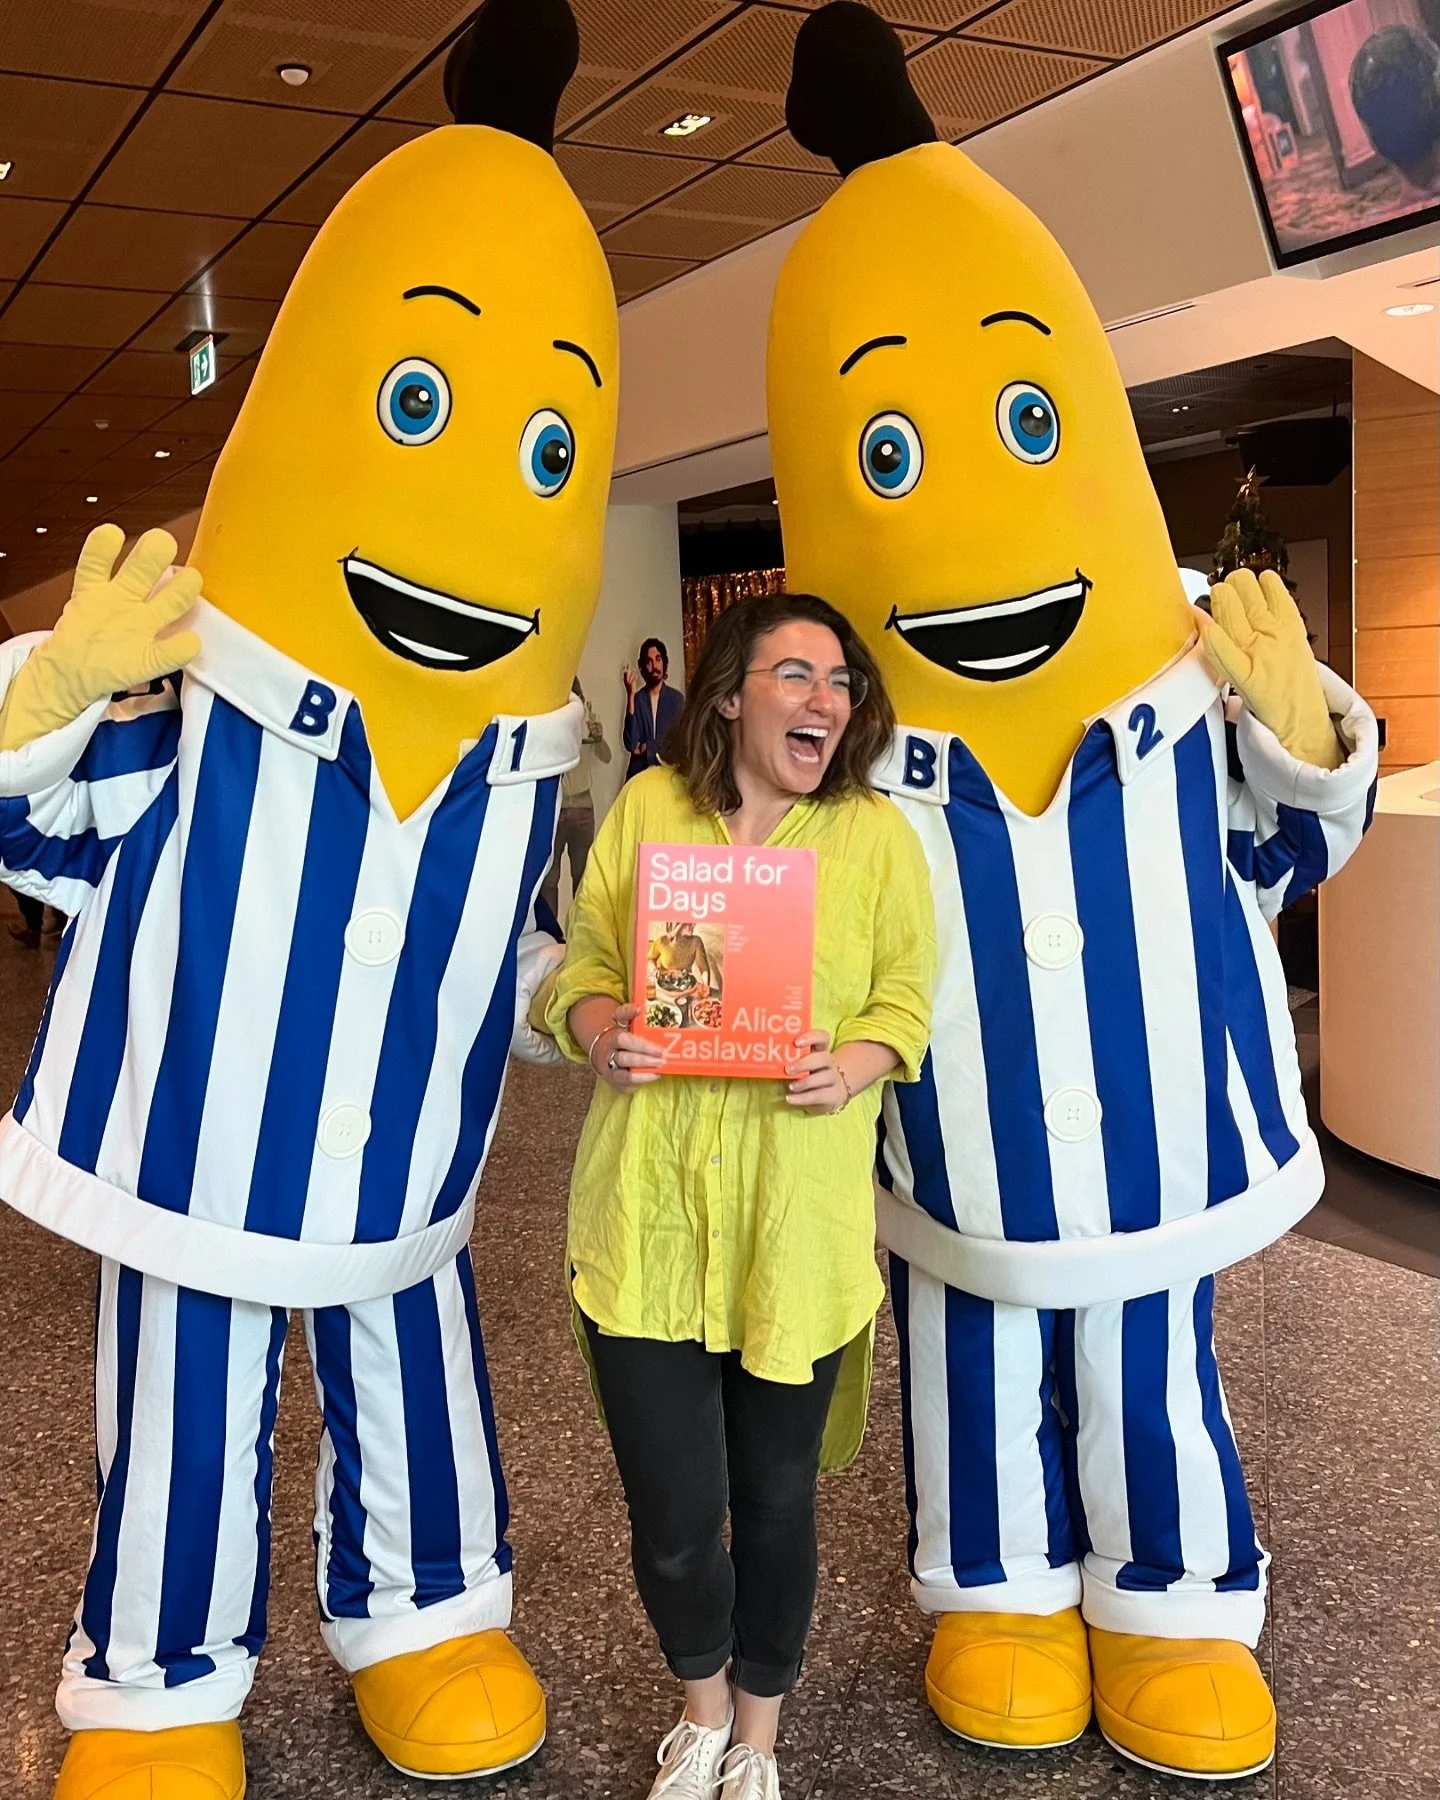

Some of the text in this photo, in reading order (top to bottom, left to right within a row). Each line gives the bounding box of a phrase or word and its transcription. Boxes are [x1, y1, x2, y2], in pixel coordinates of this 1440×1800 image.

[288, 679, 528, 772] B 1
[902, 703, 1165, 789] B 2
[650, 852, 789, 886] Salad for
[648, 882, 727, 920] Days
[731, 1007, 803, 1034] Alice
